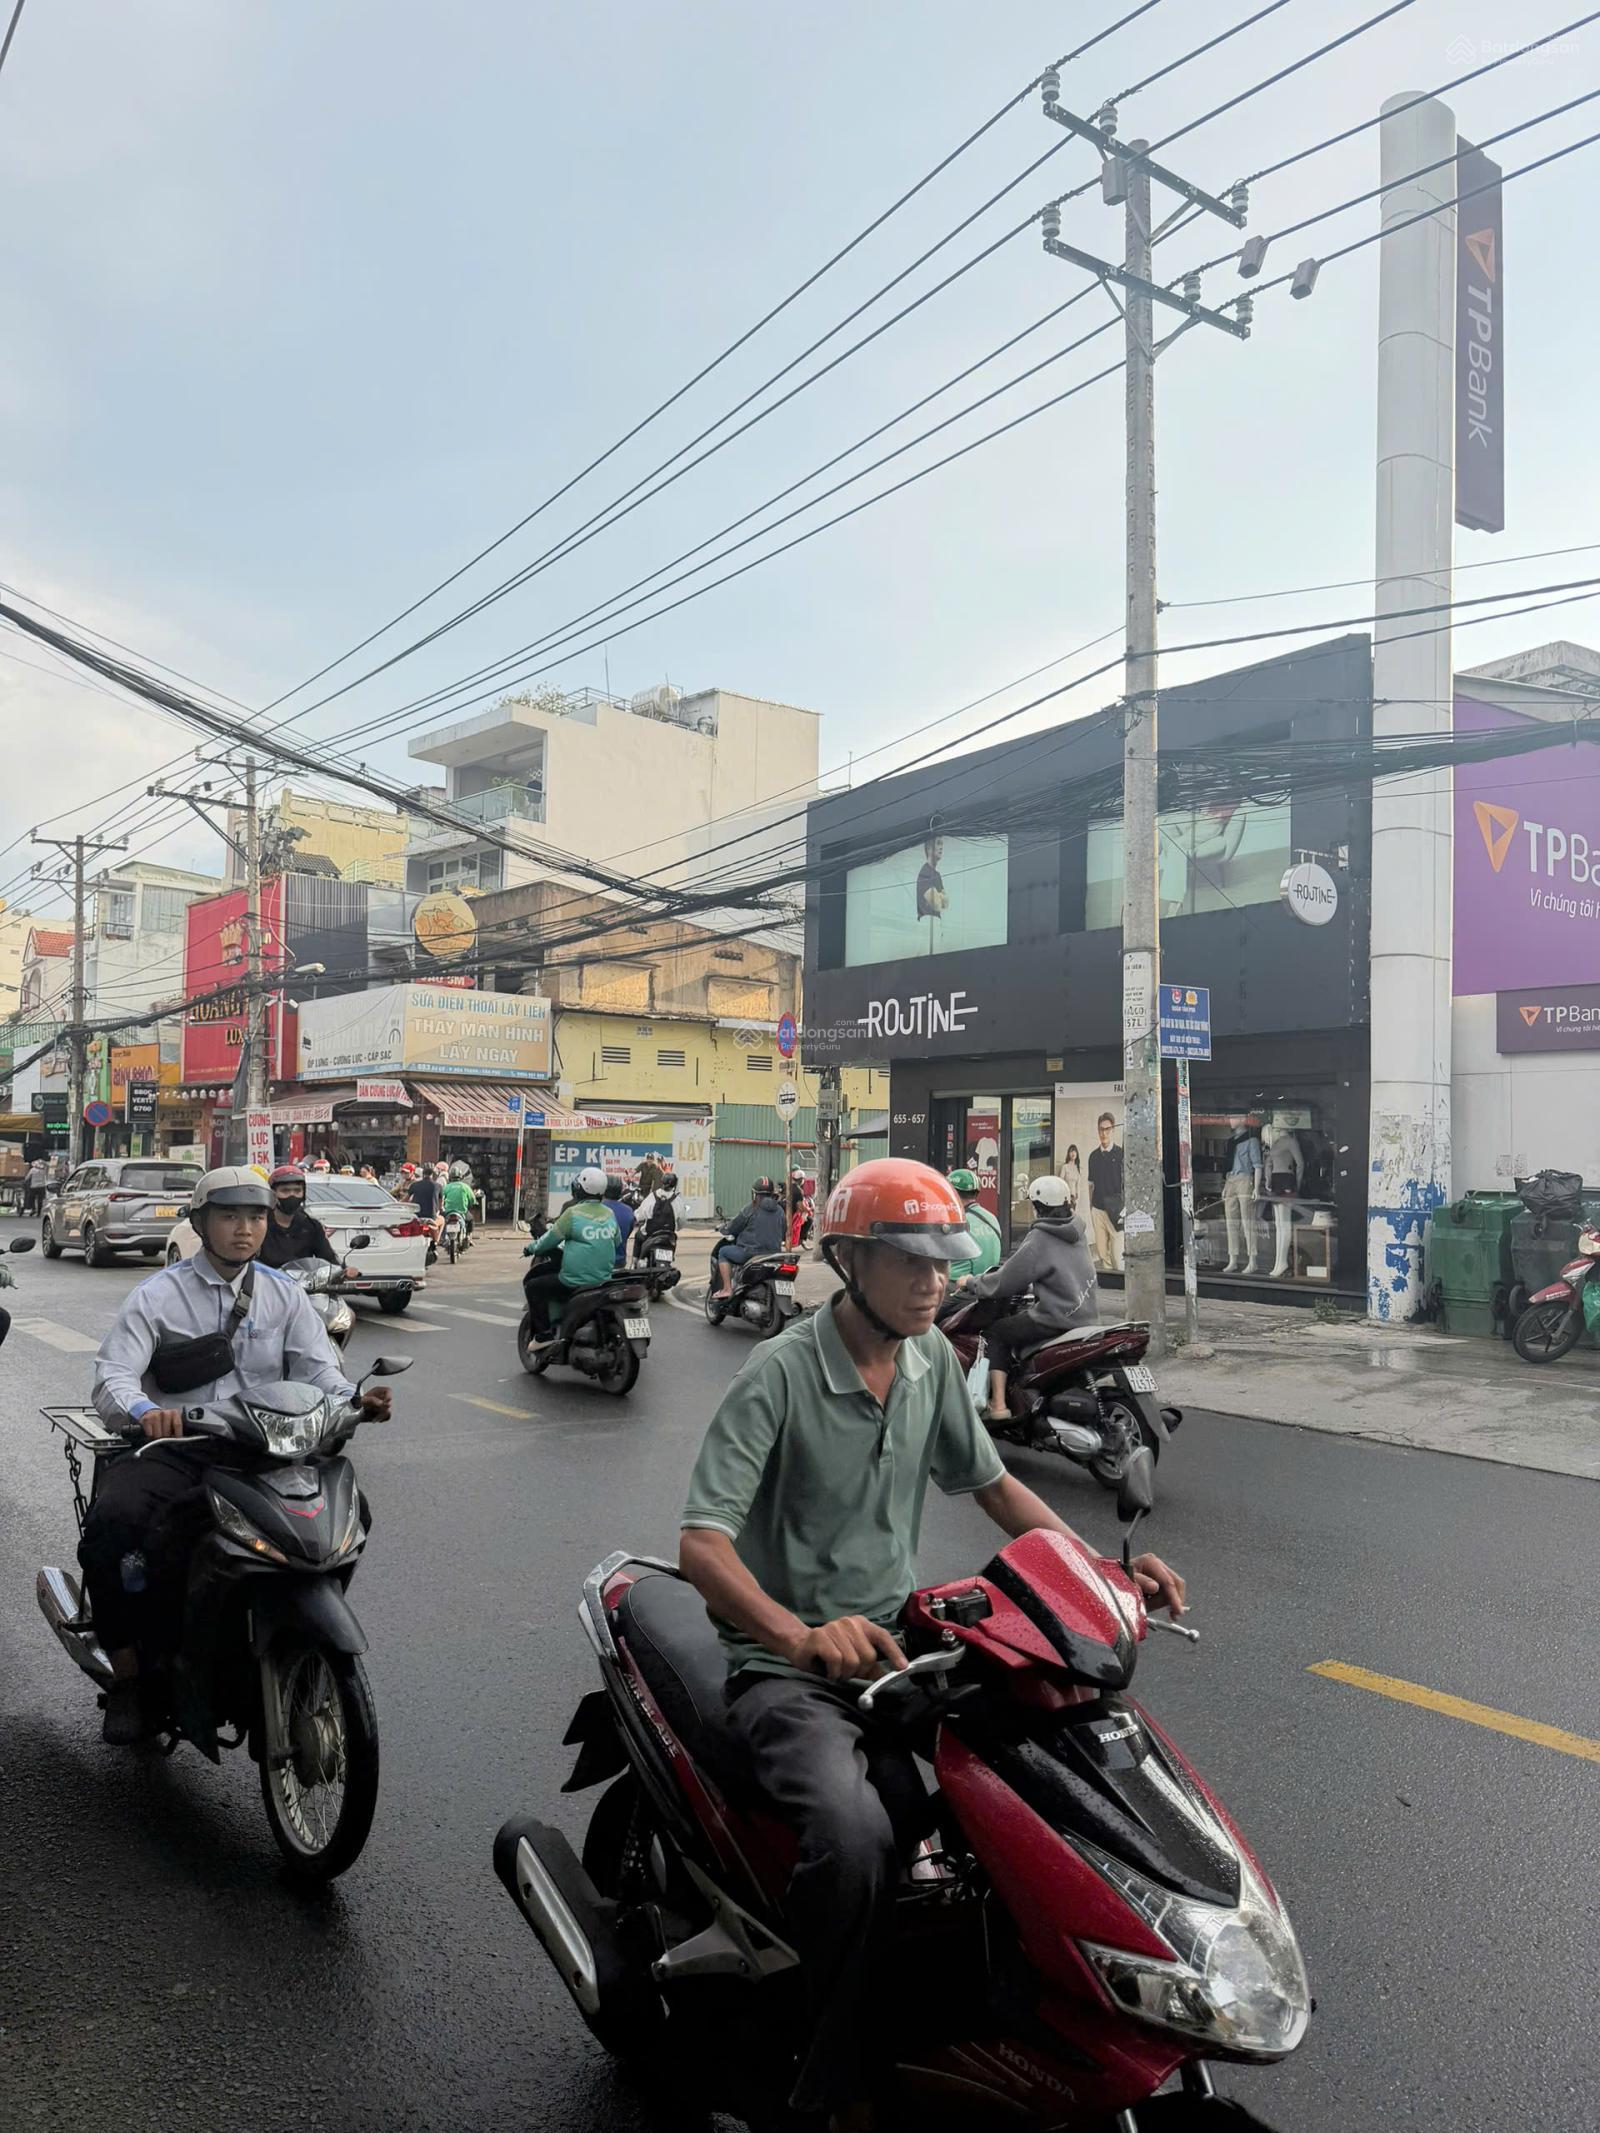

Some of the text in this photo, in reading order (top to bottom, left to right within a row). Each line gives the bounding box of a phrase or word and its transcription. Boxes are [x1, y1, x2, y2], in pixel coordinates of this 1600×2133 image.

[1468, 284, 1493, 449] TPBank
[1523, 820, 1600, 888] TPBa
[1292, 883, 1336, 905] ROUTINE
[1543, 893, 1577, 918] chúng
[1580, 899, 1594, 918] tôi
[857, 991, 979, 1040] ROUTINE
[1543, 1005, 1600, 1024] TPBan
[413, 1018, 455, 1035] THAY
[477, 1047, 518, 1063] NGAY
[252, 1151, 269, 1165] 15K
[554, 1144, 580, 1163] ÉP
[582, 1226, 617, 1241] Grab
[999, 2040, 1080, 2104] HONDA
